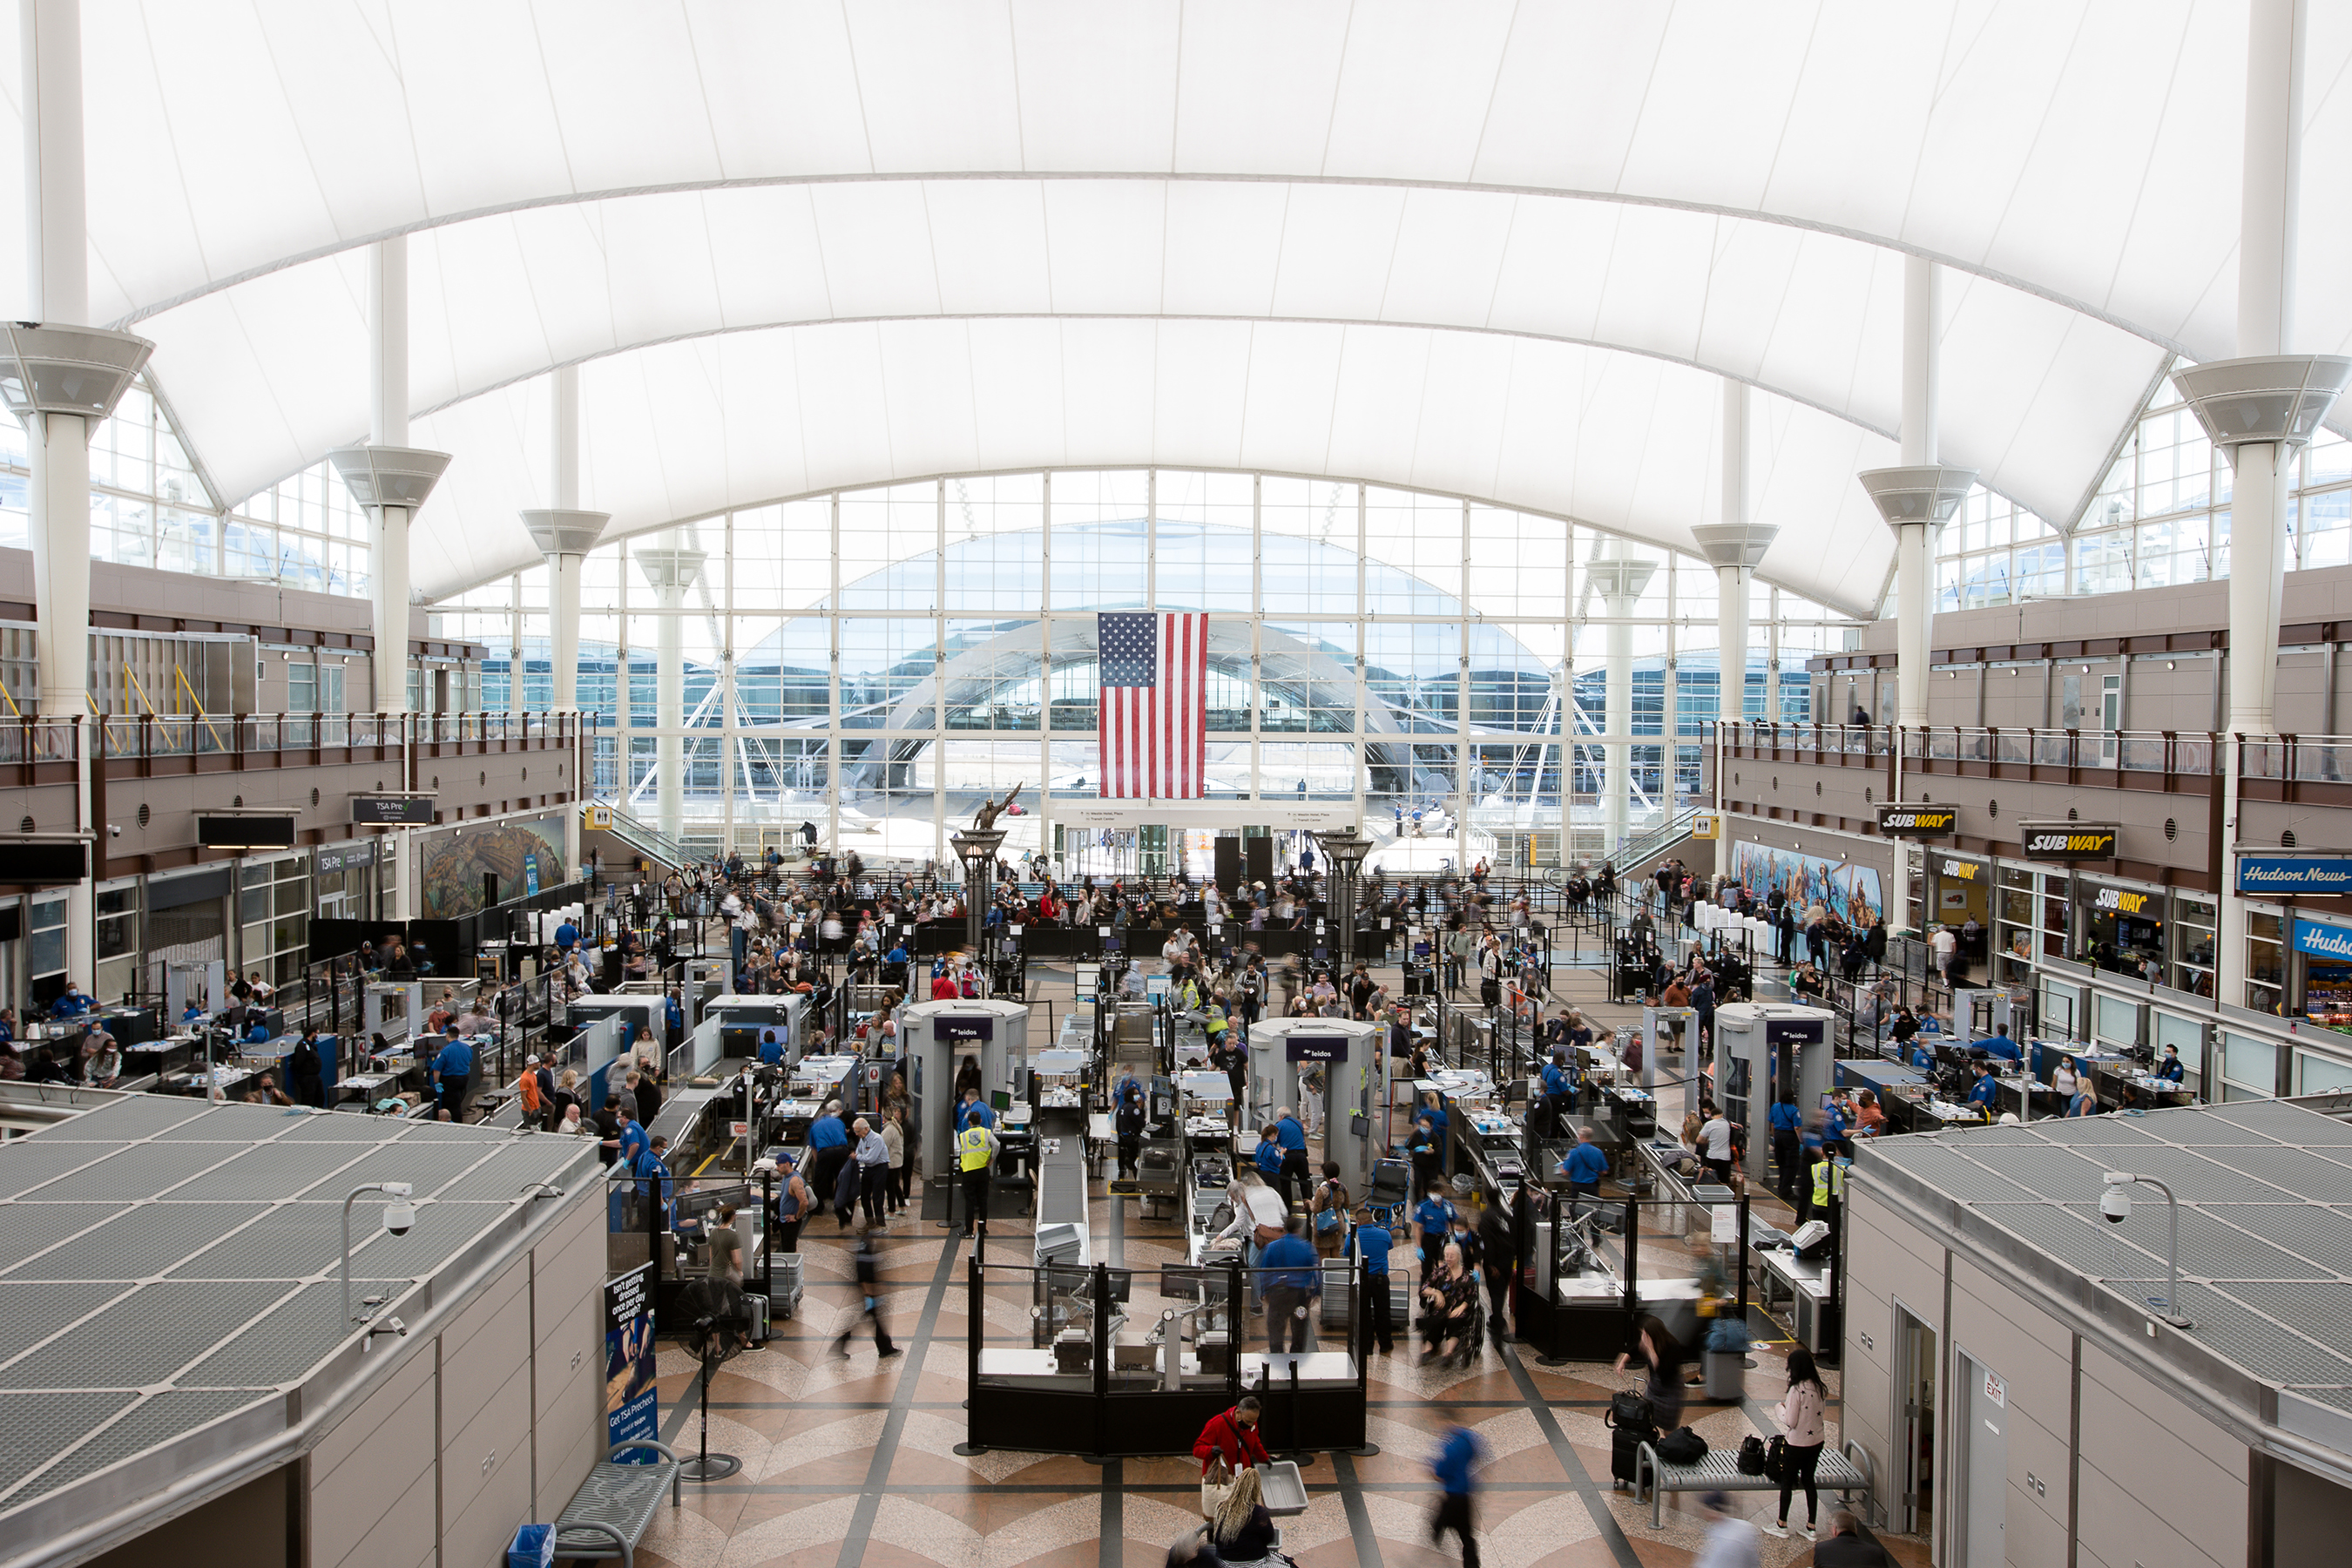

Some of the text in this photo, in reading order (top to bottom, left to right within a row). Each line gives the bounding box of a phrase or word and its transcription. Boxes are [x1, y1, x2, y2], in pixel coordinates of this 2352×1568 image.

[1882, 814, 1953, 828] SUBWAY
[2028, 835, 2113, 851] SUBWAY
[321, 857, 332, 870] TSA
[1943, 859, 1979, 880] SUBWAY
[2244, 867, 2352, 882] Hudson News
[2095, 888, 2148, 913] SUBWAY
[1162, 1101, 1167, 1110] 9
[613, 1273, 645, 1294] Isn't getting
[618, 1284, 639, 1301] dressed
[612, 1292, 645, 1315] once per day
[618, 1303, 641, 1322] enough?
[1987, 1382, 2002, 1402] EXIT
[610, 1394, 654, 1427] Get TSA Precheck
